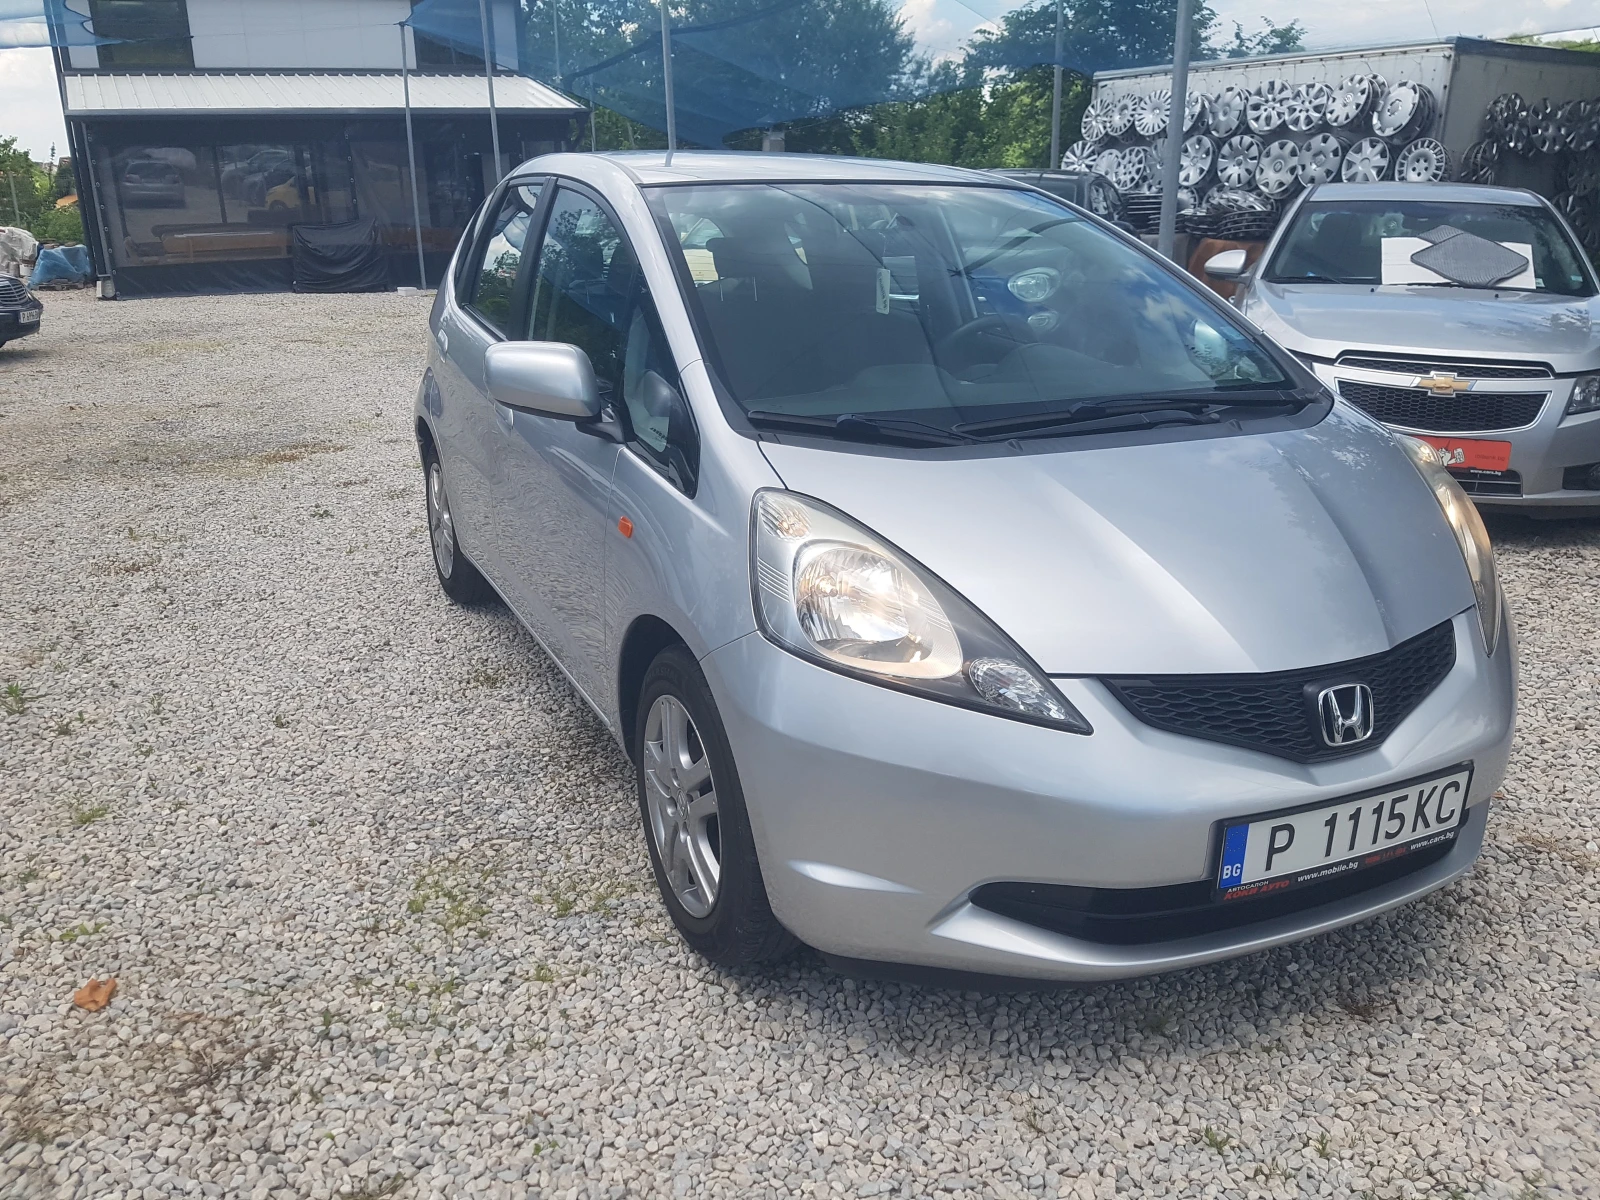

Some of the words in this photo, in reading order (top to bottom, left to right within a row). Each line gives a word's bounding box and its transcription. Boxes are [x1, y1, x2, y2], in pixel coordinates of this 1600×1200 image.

[1265, 823, 1295, 872] P
[1324, 780, 1460, 858] 1115KC
[1410, 831, 1455, 851] www.cars.bg
[1222, 863, 1241, 880] BG
[1297, 861, 1359, 882] www.mobile.bg
[1227, 880, 1269, 893] АВТОСАЛОН
